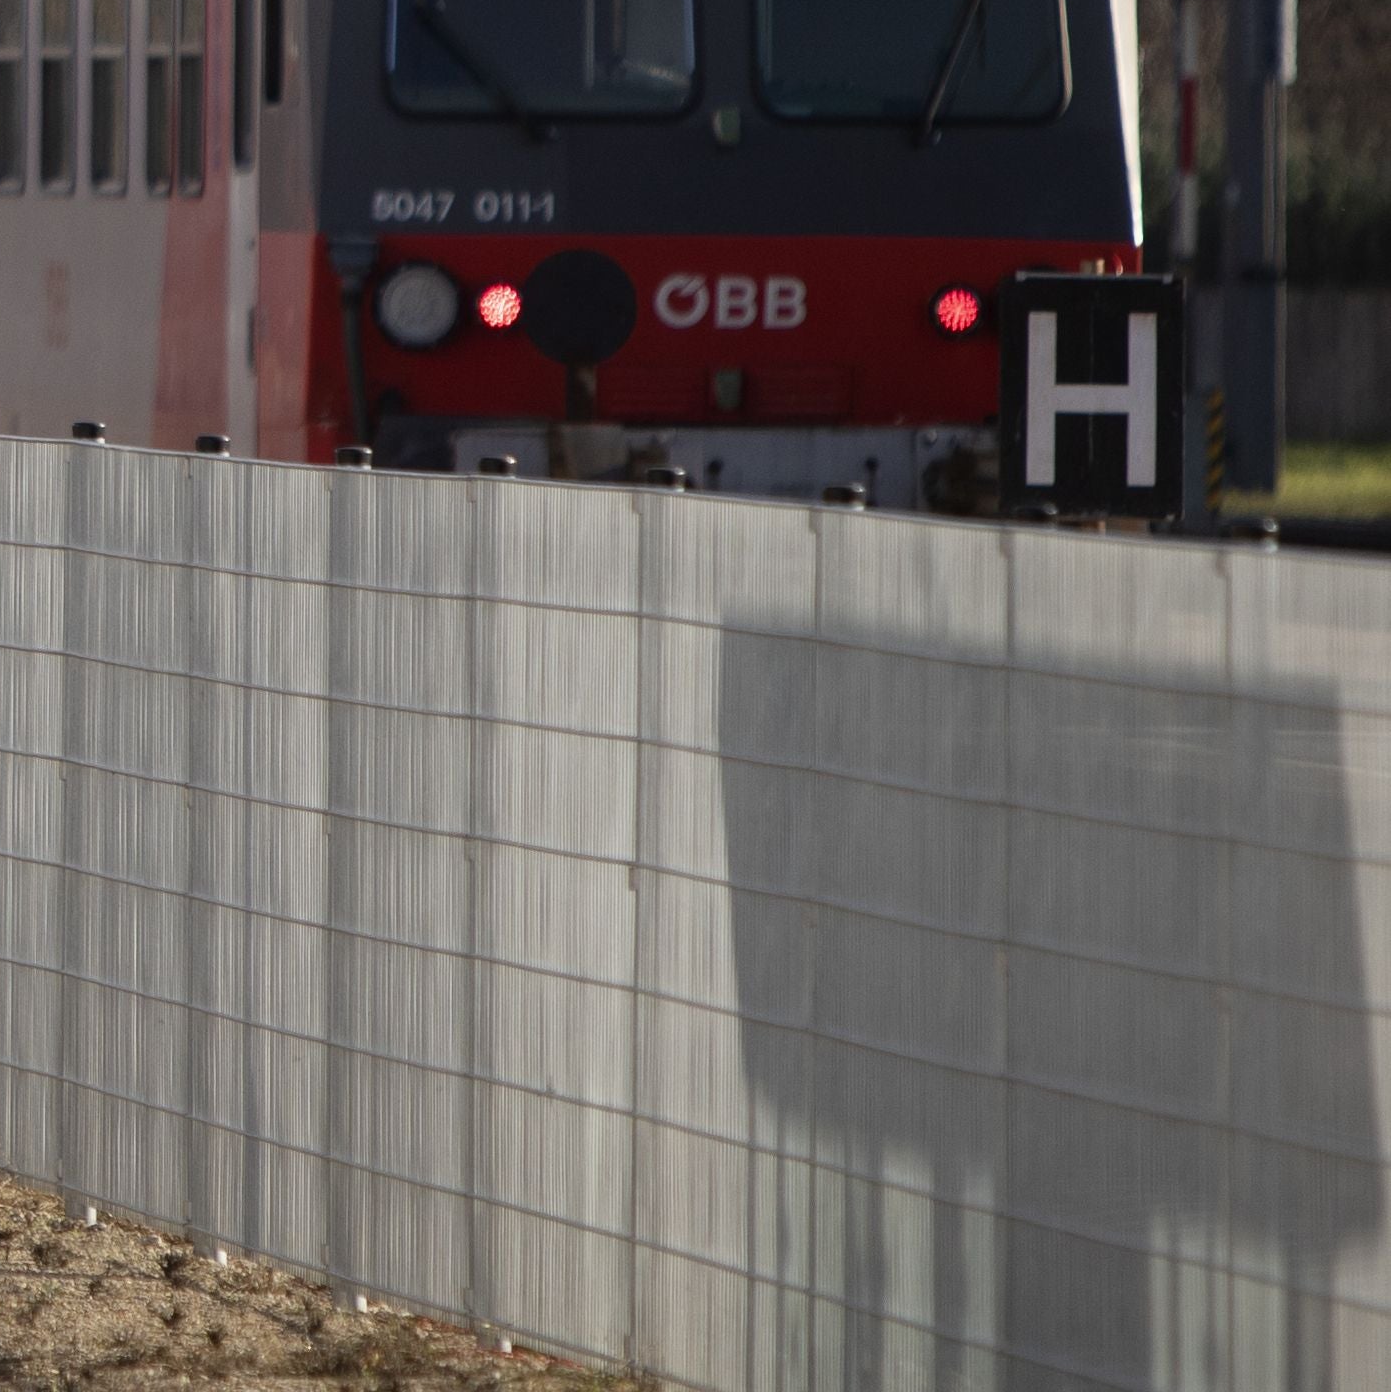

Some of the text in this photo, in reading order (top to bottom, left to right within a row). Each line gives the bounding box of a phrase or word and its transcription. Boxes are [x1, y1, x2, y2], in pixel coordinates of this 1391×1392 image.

[372, 189, 456, 223] 5047
[654, 273, 808, 329] ÖBB
[1026, 312, 1157, 487] H
